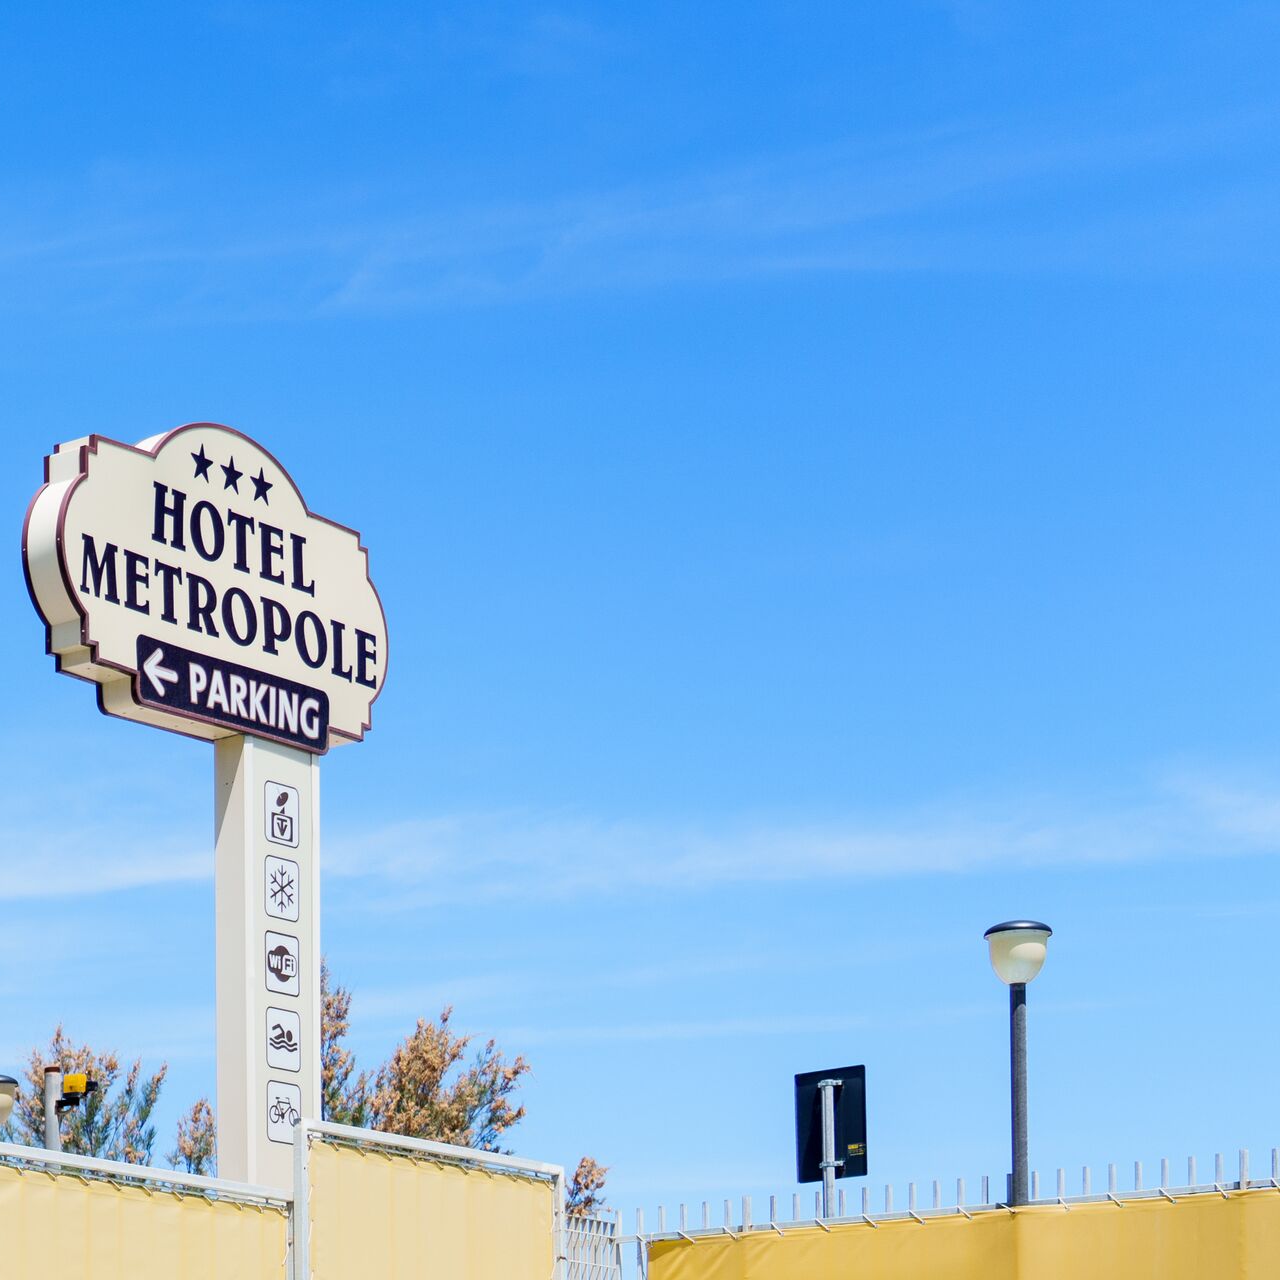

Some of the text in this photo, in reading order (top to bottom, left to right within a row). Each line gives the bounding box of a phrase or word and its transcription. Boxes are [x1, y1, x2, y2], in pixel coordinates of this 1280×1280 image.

[151, 481, 315, 598] HOTEL
[80, 533, 377, 689] METROPOLE
[189, 662, 319, 740] PARKING
